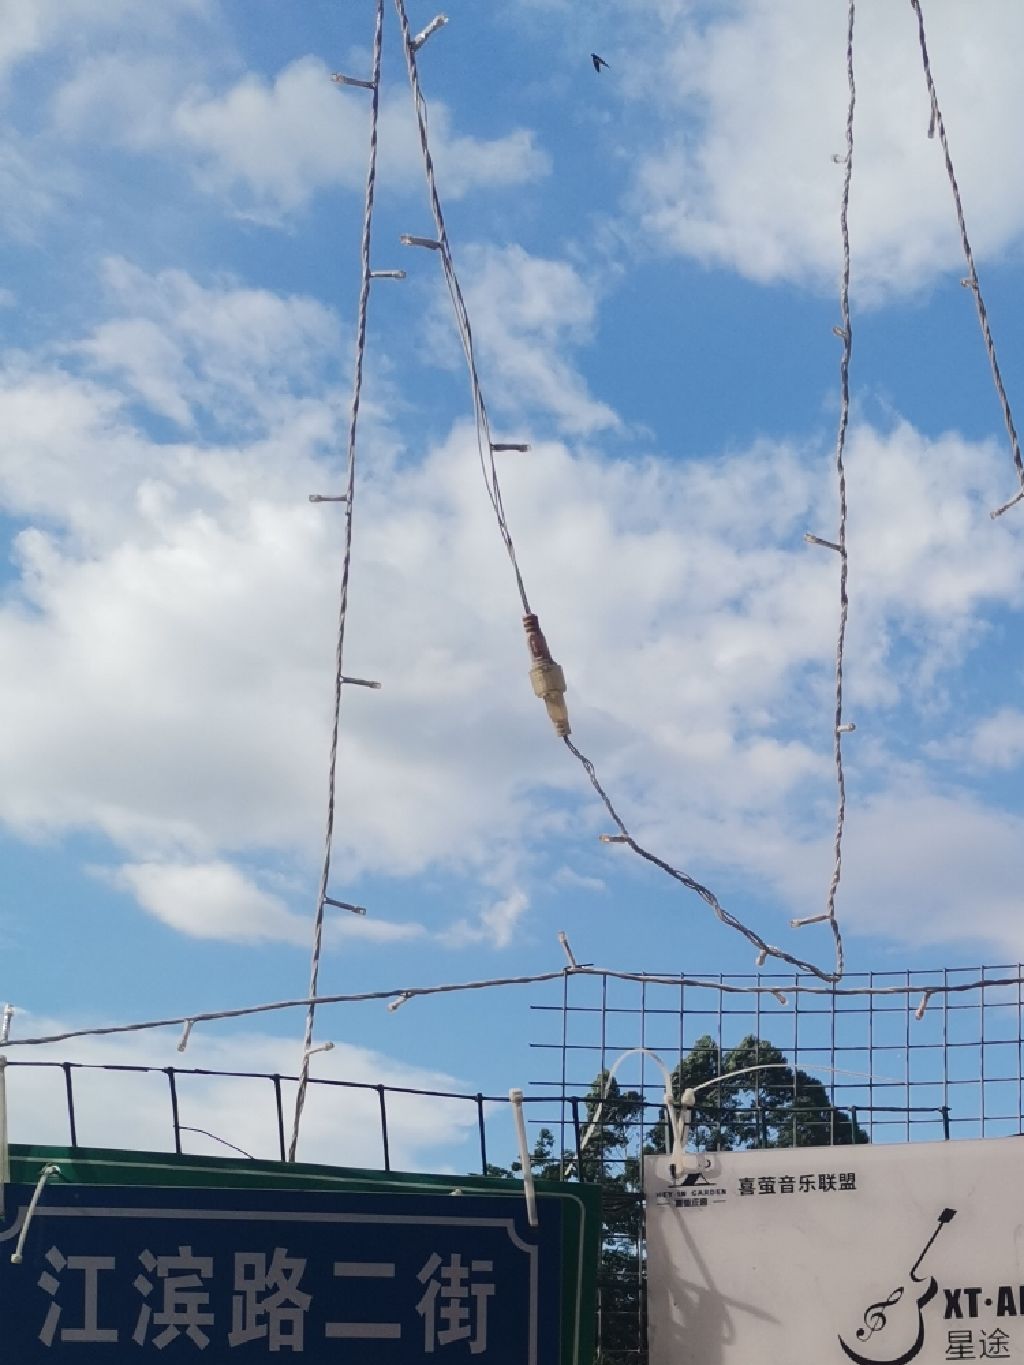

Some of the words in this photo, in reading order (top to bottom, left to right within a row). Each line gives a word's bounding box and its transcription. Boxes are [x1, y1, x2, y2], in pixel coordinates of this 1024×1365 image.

[738, 1172, 857, 1197] 喜萤音乐联盟
[38, 1246, 496, 1354] 江滨路二街
[945, 1327, 1011, 1360] 星途
